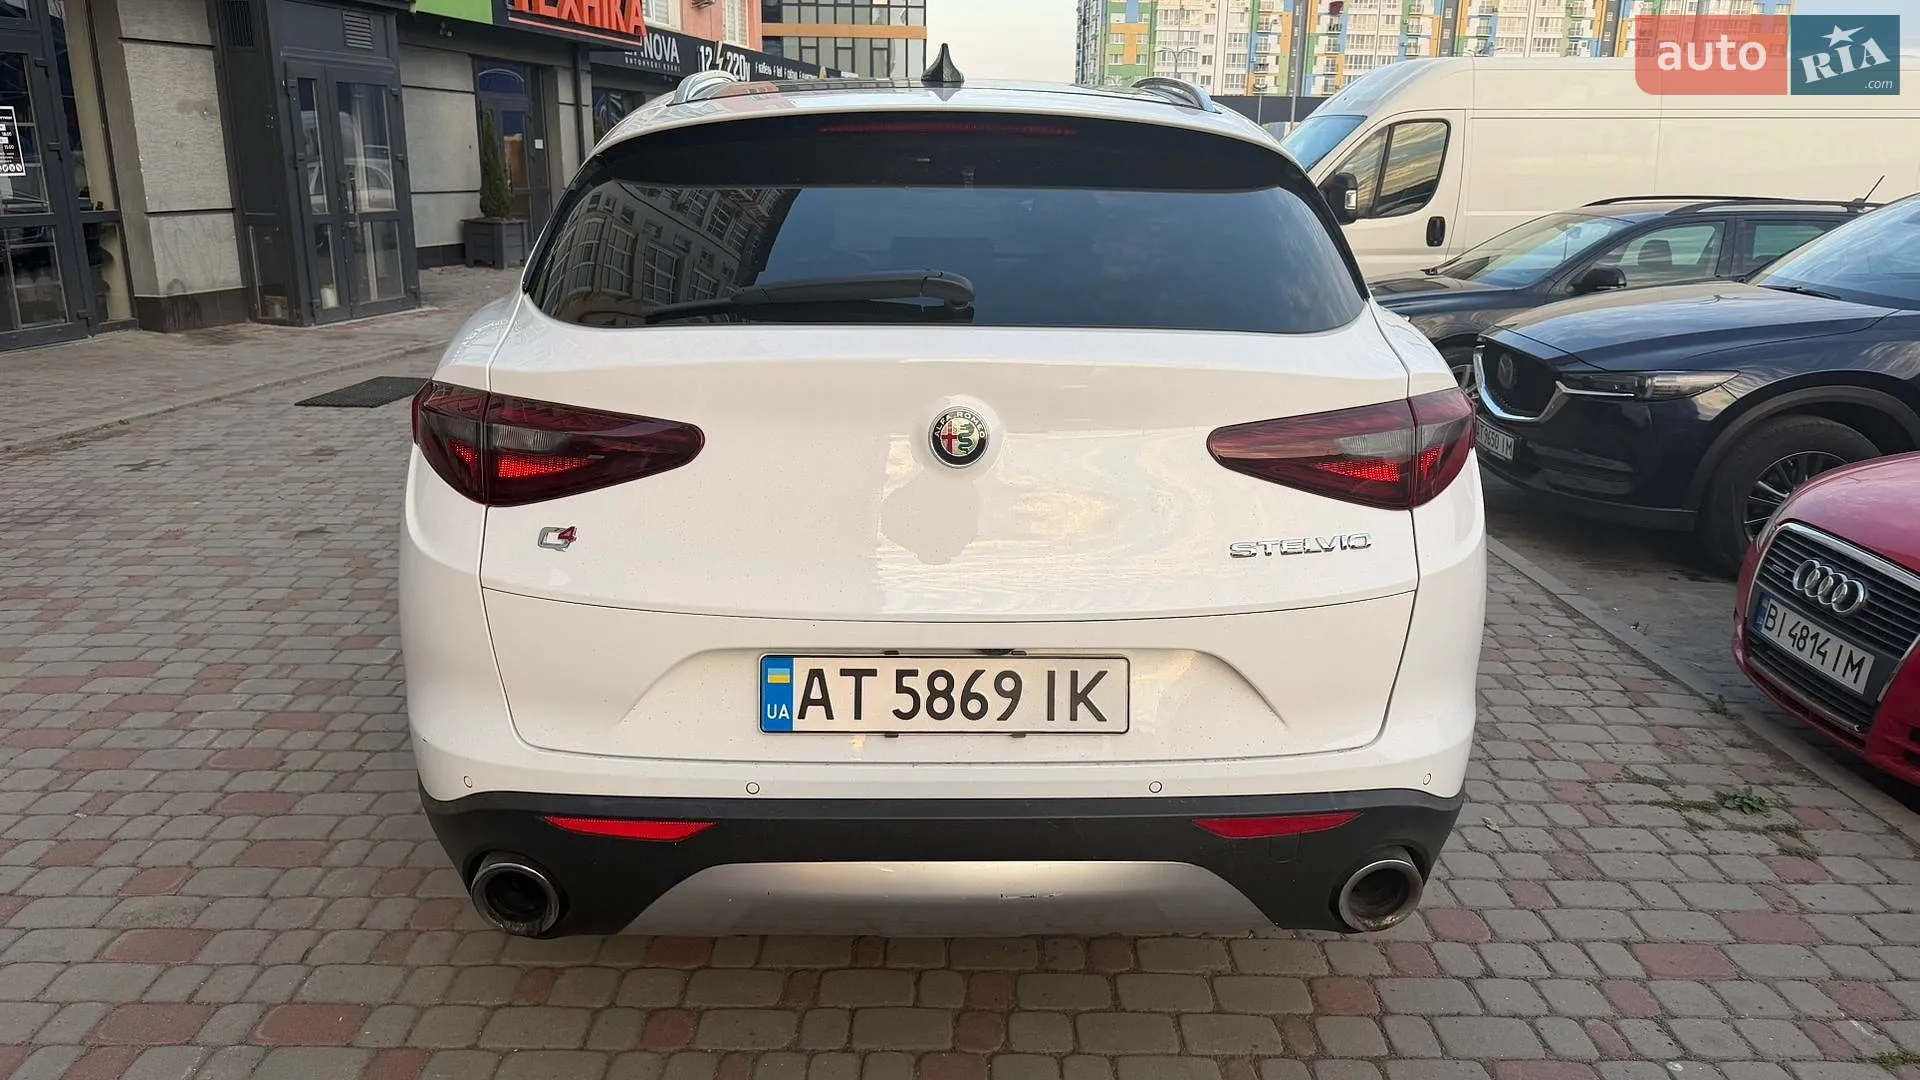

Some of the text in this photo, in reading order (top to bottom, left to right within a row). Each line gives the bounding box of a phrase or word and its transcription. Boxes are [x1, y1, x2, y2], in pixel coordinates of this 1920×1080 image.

[514, 0, 648, 37] ХНІКА
[624, 32, 680, 64] NOVA
[934, 411, 985, 438] ALFA ROMEO
[538, 526, 577, 552] Q4
[1229, 532, 1373, 558] STELVIO
[1764, 603, 1866, 685] BI 4814 IM
[797, 668, 1108, 722] AT 5869 IK
[767, 704, 790, 720] UA
